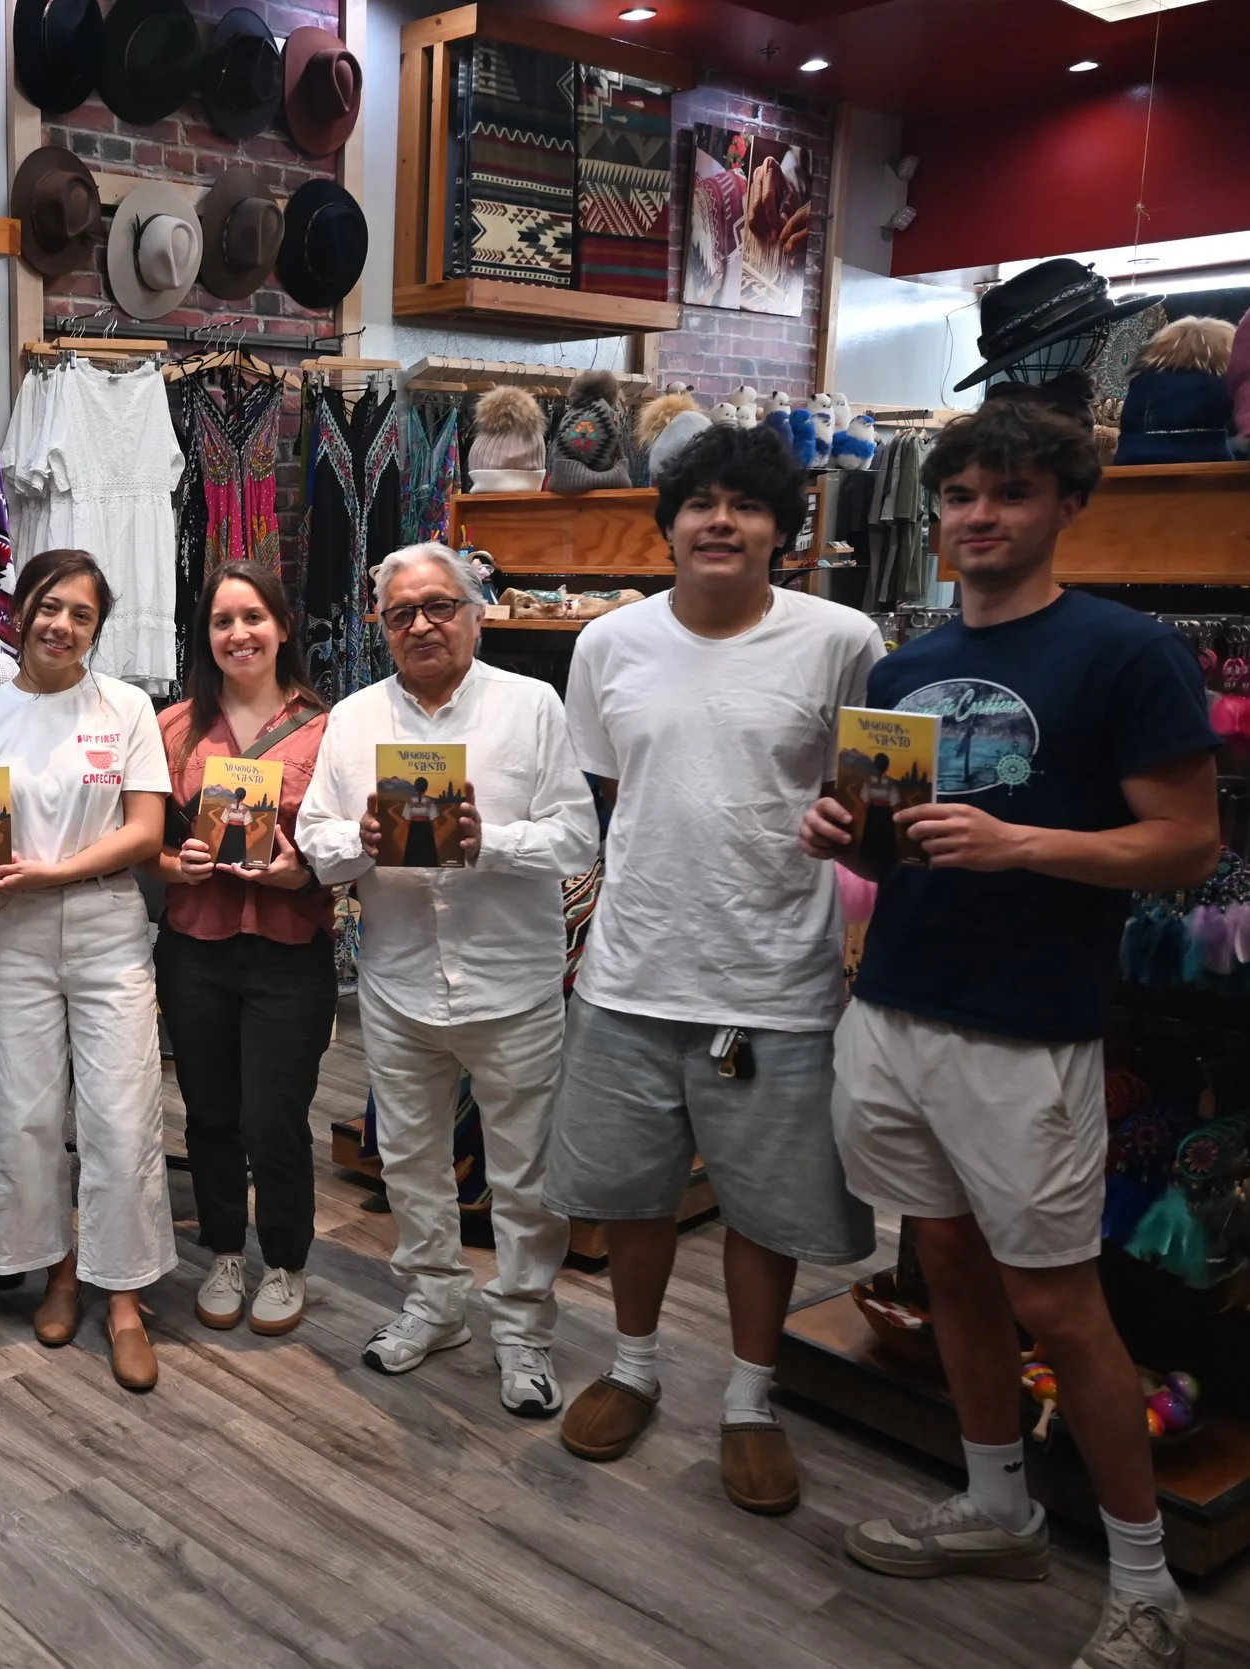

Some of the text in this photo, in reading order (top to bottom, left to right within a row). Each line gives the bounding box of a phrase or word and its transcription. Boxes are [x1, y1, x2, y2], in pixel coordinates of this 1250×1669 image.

[77, 733, 120, 744] BUT FIRST
[82, 773, 122, 785] CAFECITO
